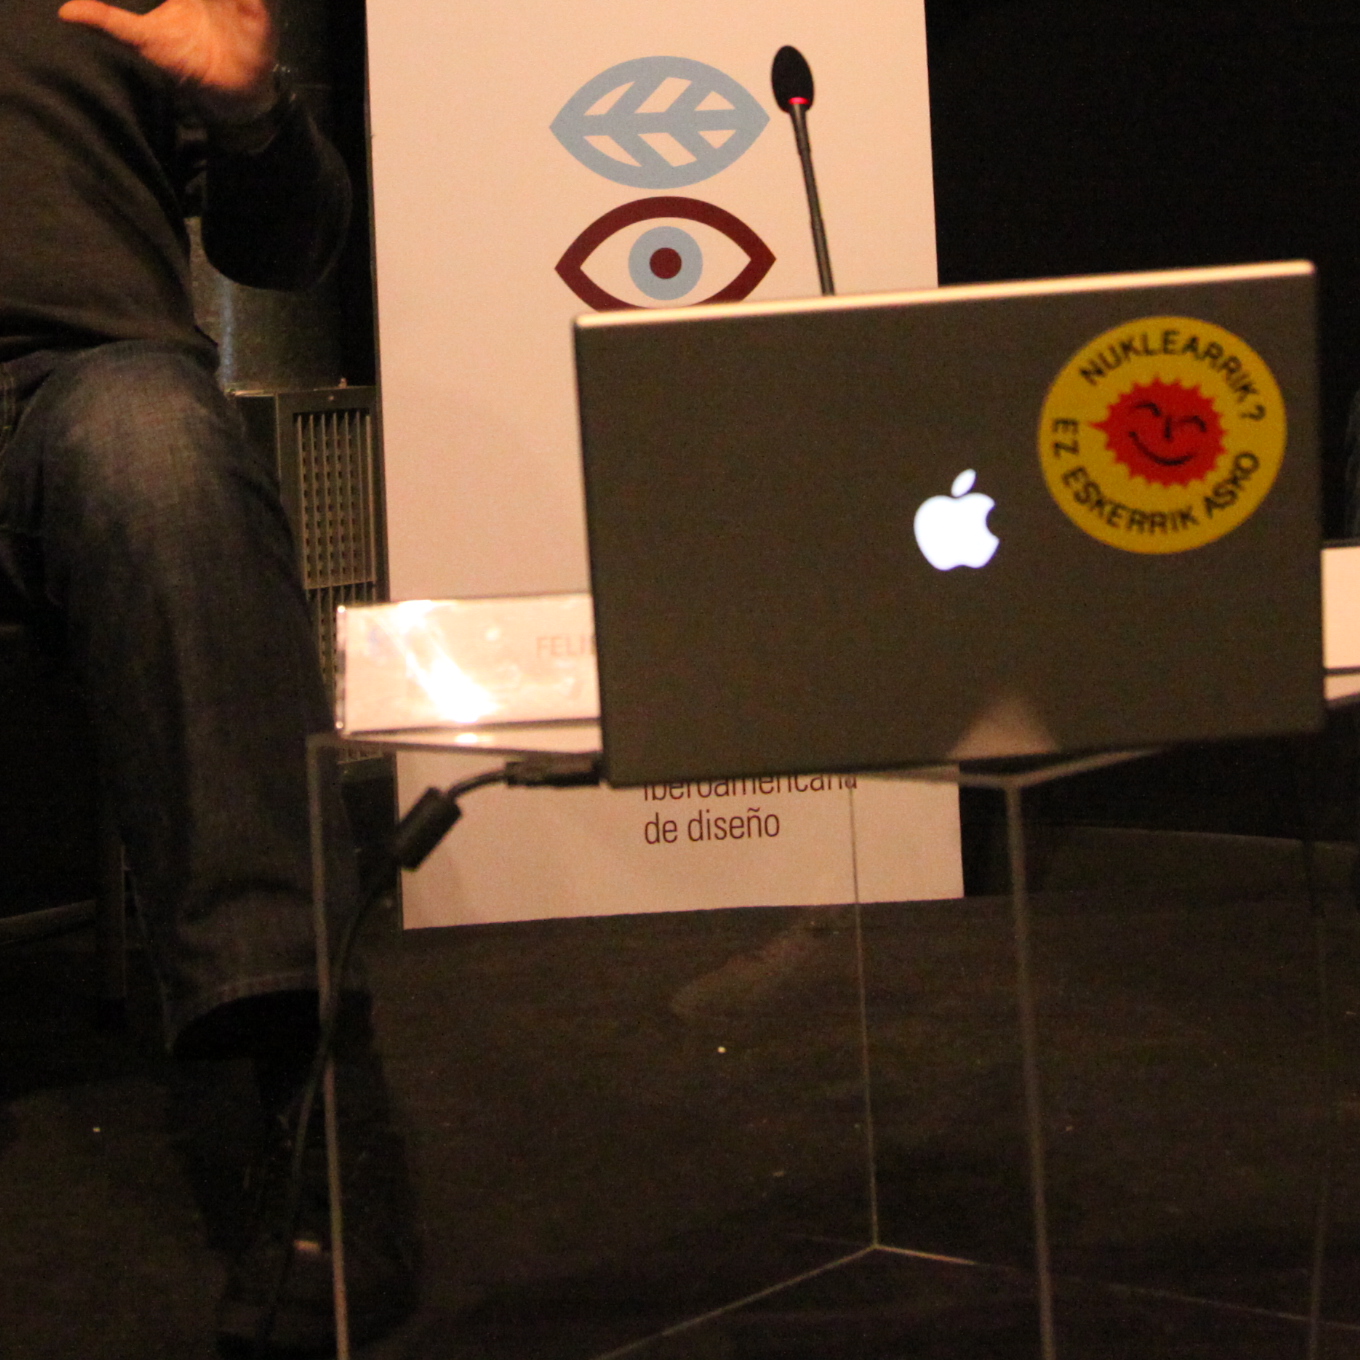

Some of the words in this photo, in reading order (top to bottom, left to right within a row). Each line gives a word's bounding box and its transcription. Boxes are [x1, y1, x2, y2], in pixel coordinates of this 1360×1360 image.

[1051, 417, 1080, 459] EZ
[1061, 466, 1199, 535] ESKERRIK
[1202, 450, 1261, 520] ASKO
[644, 812, 678, 845] de
[687, 807, 781, 843] diseño
